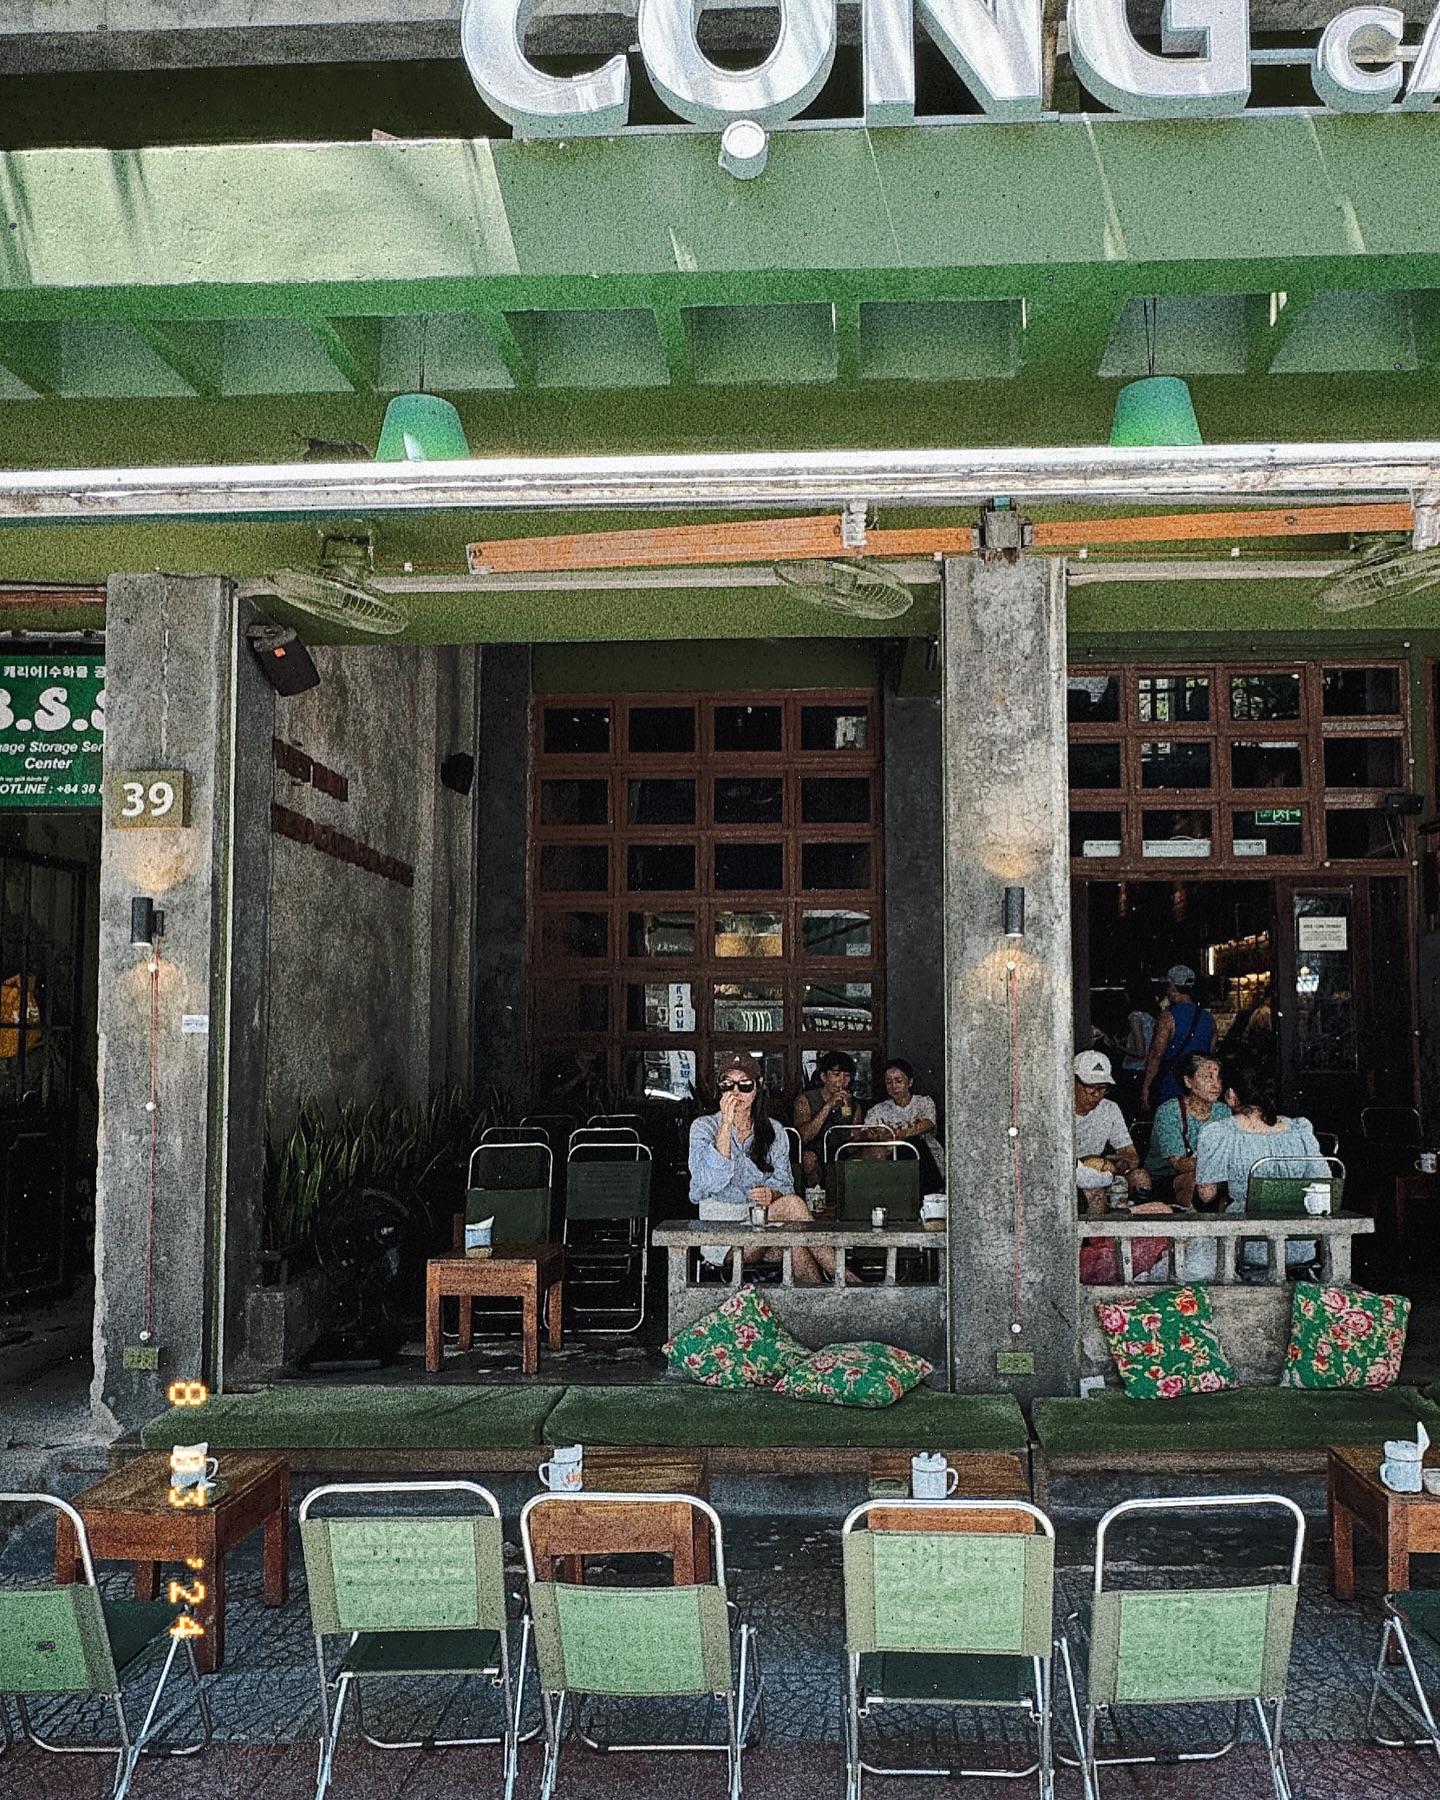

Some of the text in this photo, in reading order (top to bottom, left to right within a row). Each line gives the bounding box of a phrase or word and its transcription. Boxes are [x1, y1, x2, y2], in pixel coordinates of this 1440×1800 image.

[29, 740, 78, 756] Storage
[24, 757, 73, 770] Center
[121, 781, 174, 818] 39
